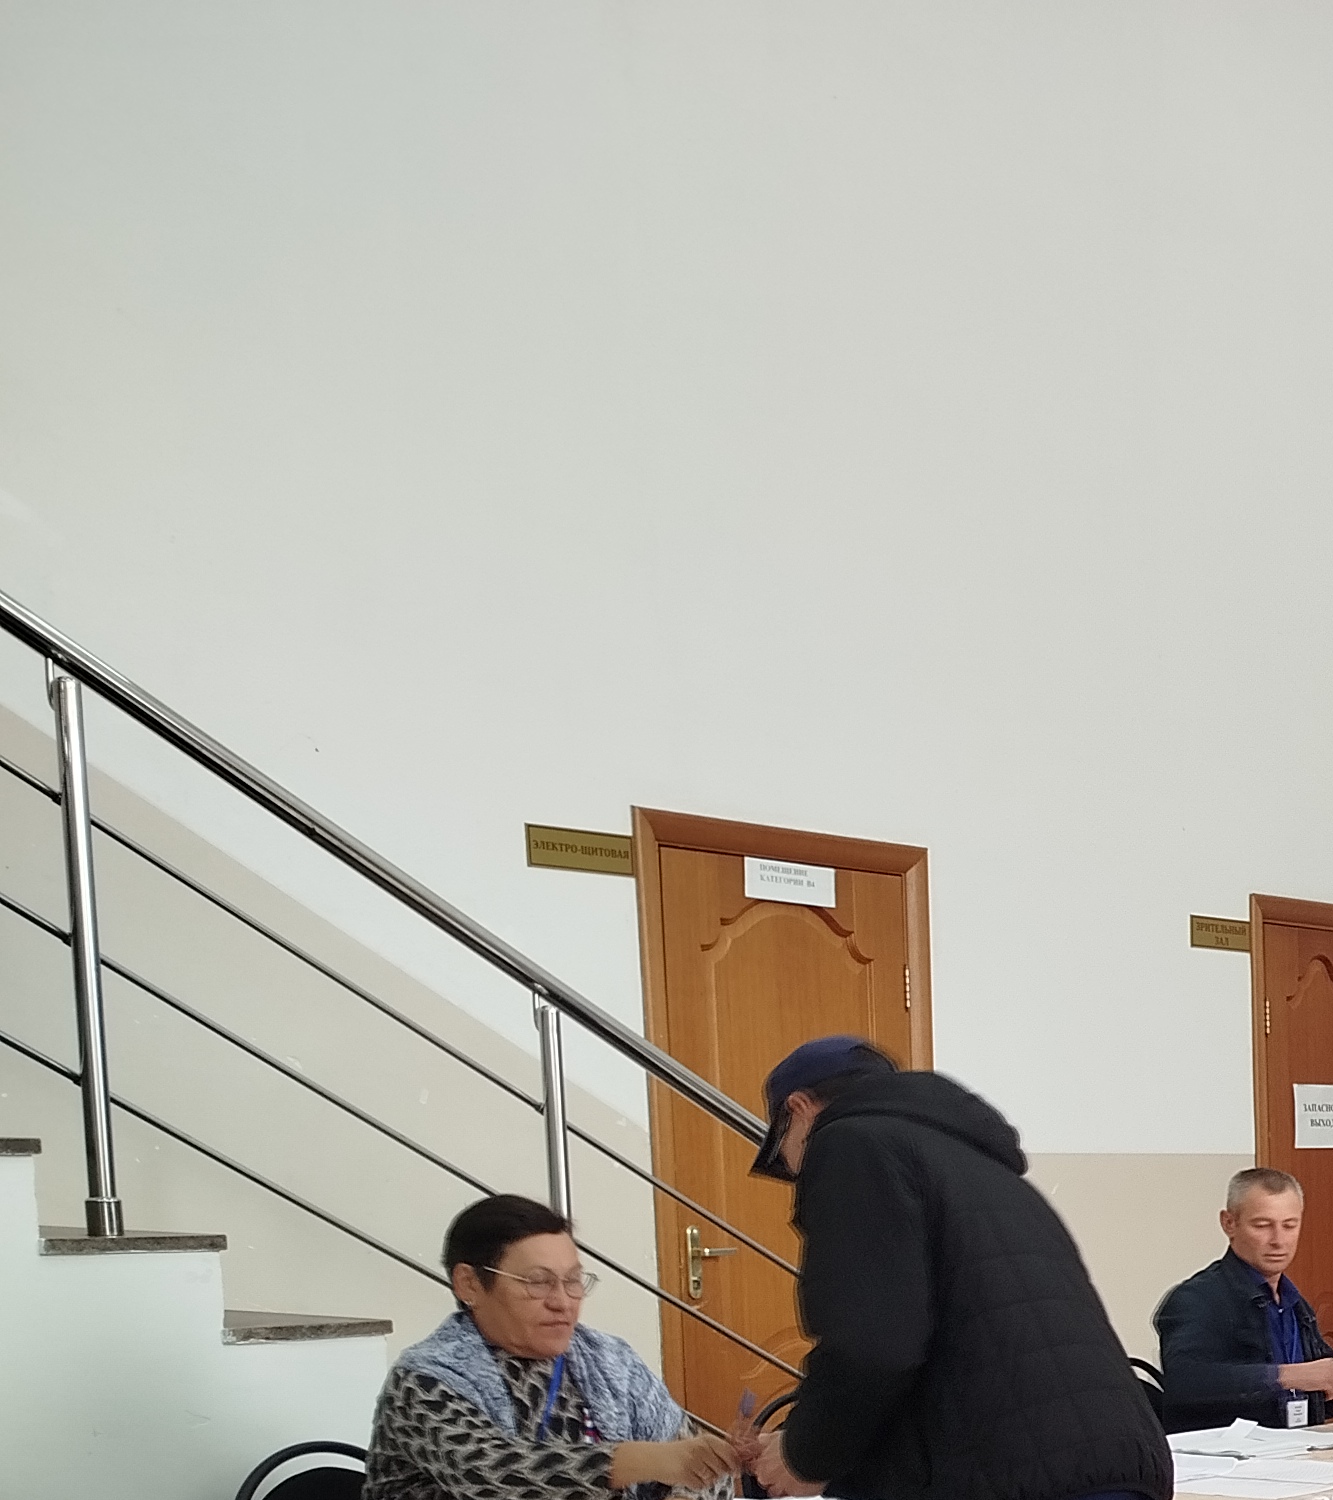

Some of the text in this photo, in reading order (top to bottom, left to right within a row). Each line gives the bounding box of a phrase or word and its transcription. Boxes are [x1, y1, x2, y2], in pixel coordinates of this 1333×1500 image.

[532, 839, 630, 860] ЭЛЕКТРО-ЩИТОВАЯ
[1196, 922, 1246, 936] ЗРИТЕЛЬНЫЙ
[1215, 936, 1229, 946] ЗАЛ
